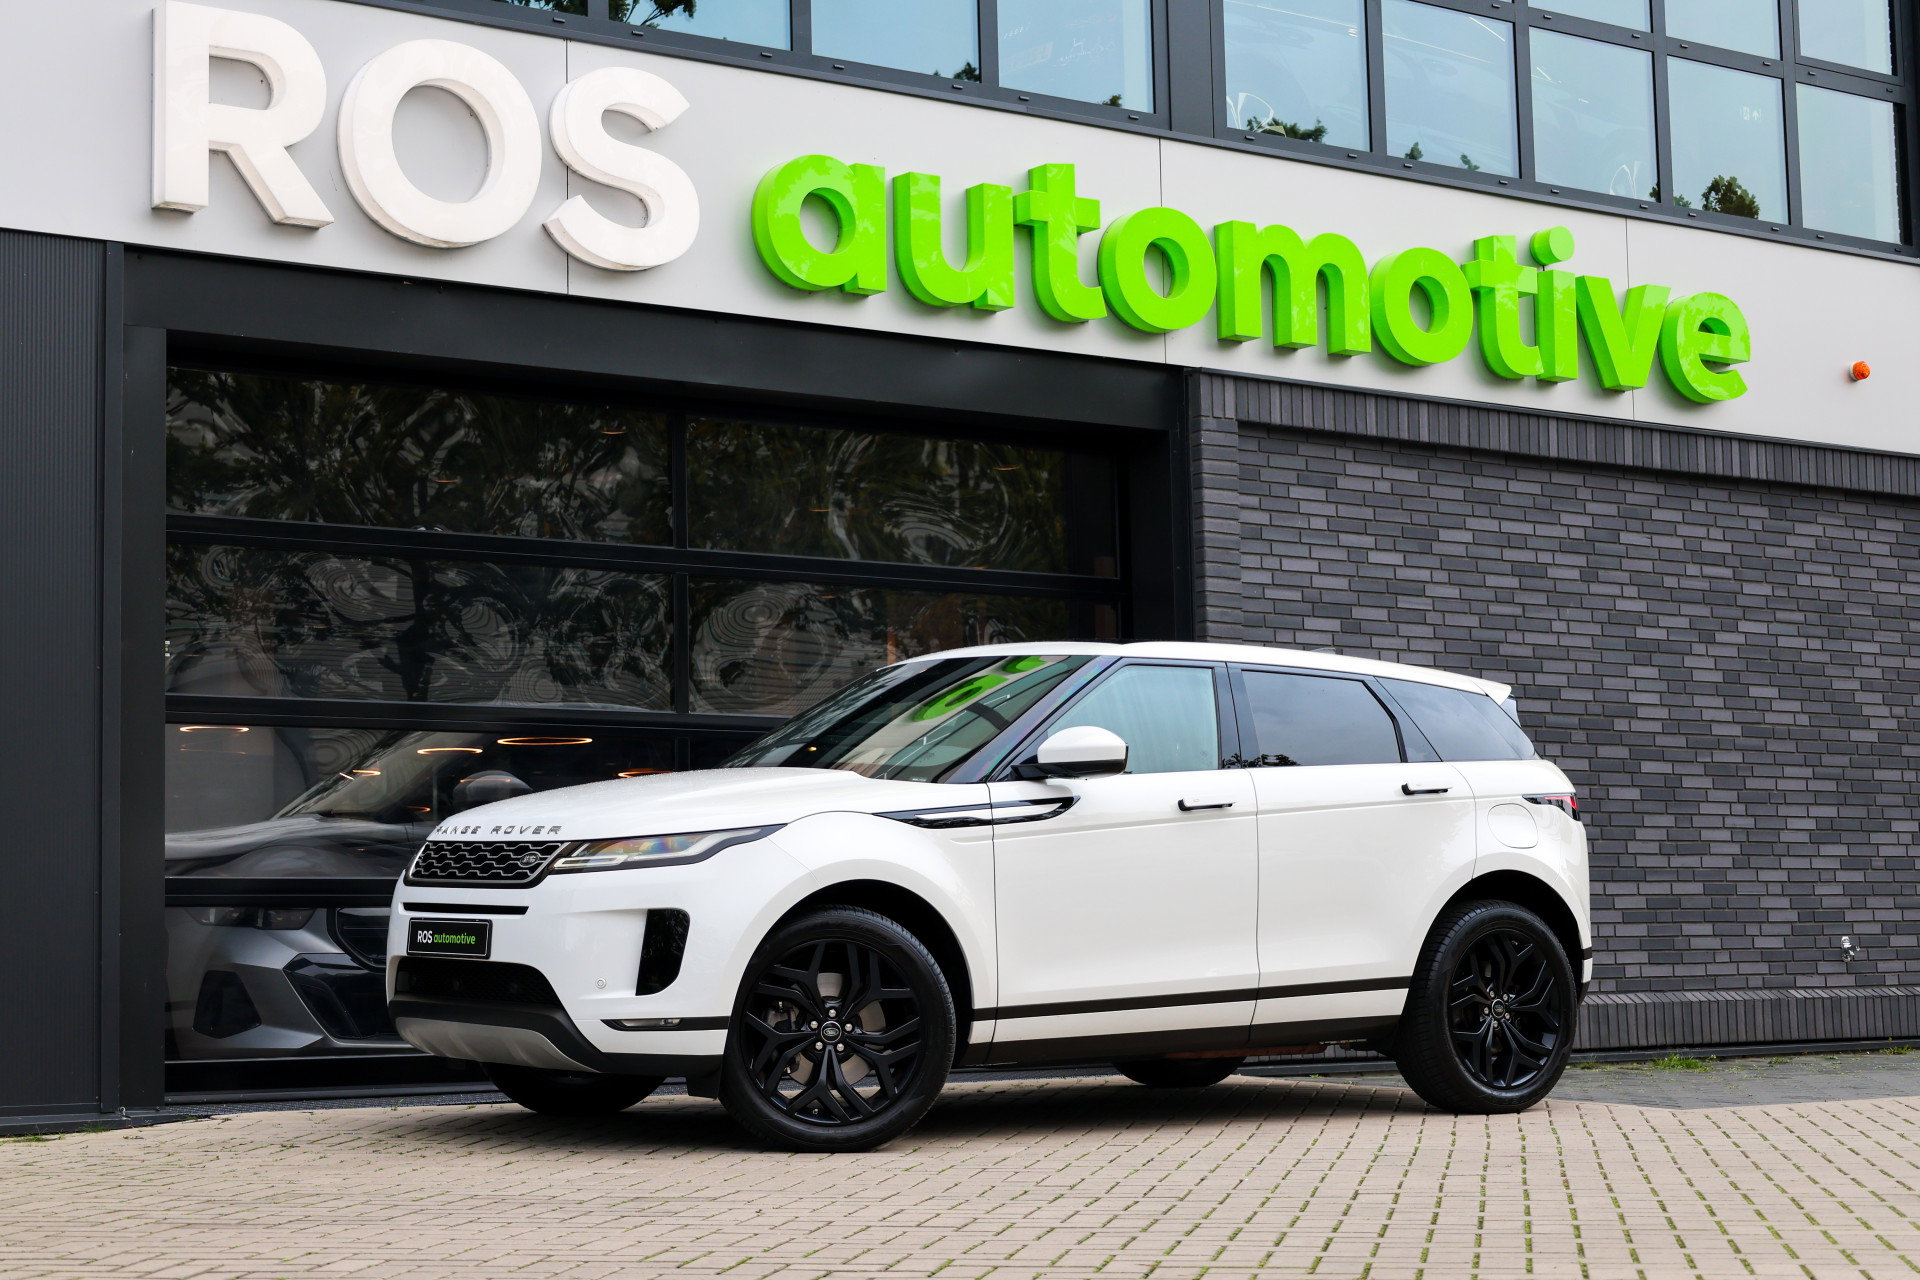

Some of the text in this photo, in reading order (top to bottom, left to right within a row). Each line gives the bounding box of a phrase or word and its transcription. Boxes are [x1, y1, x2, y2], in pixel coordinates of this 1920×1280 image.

[151, 1, 1751, 403] ROS automotive
[490, 825, 562, 835] ROVER
[417, 930, 476, 945] ROS automotive
